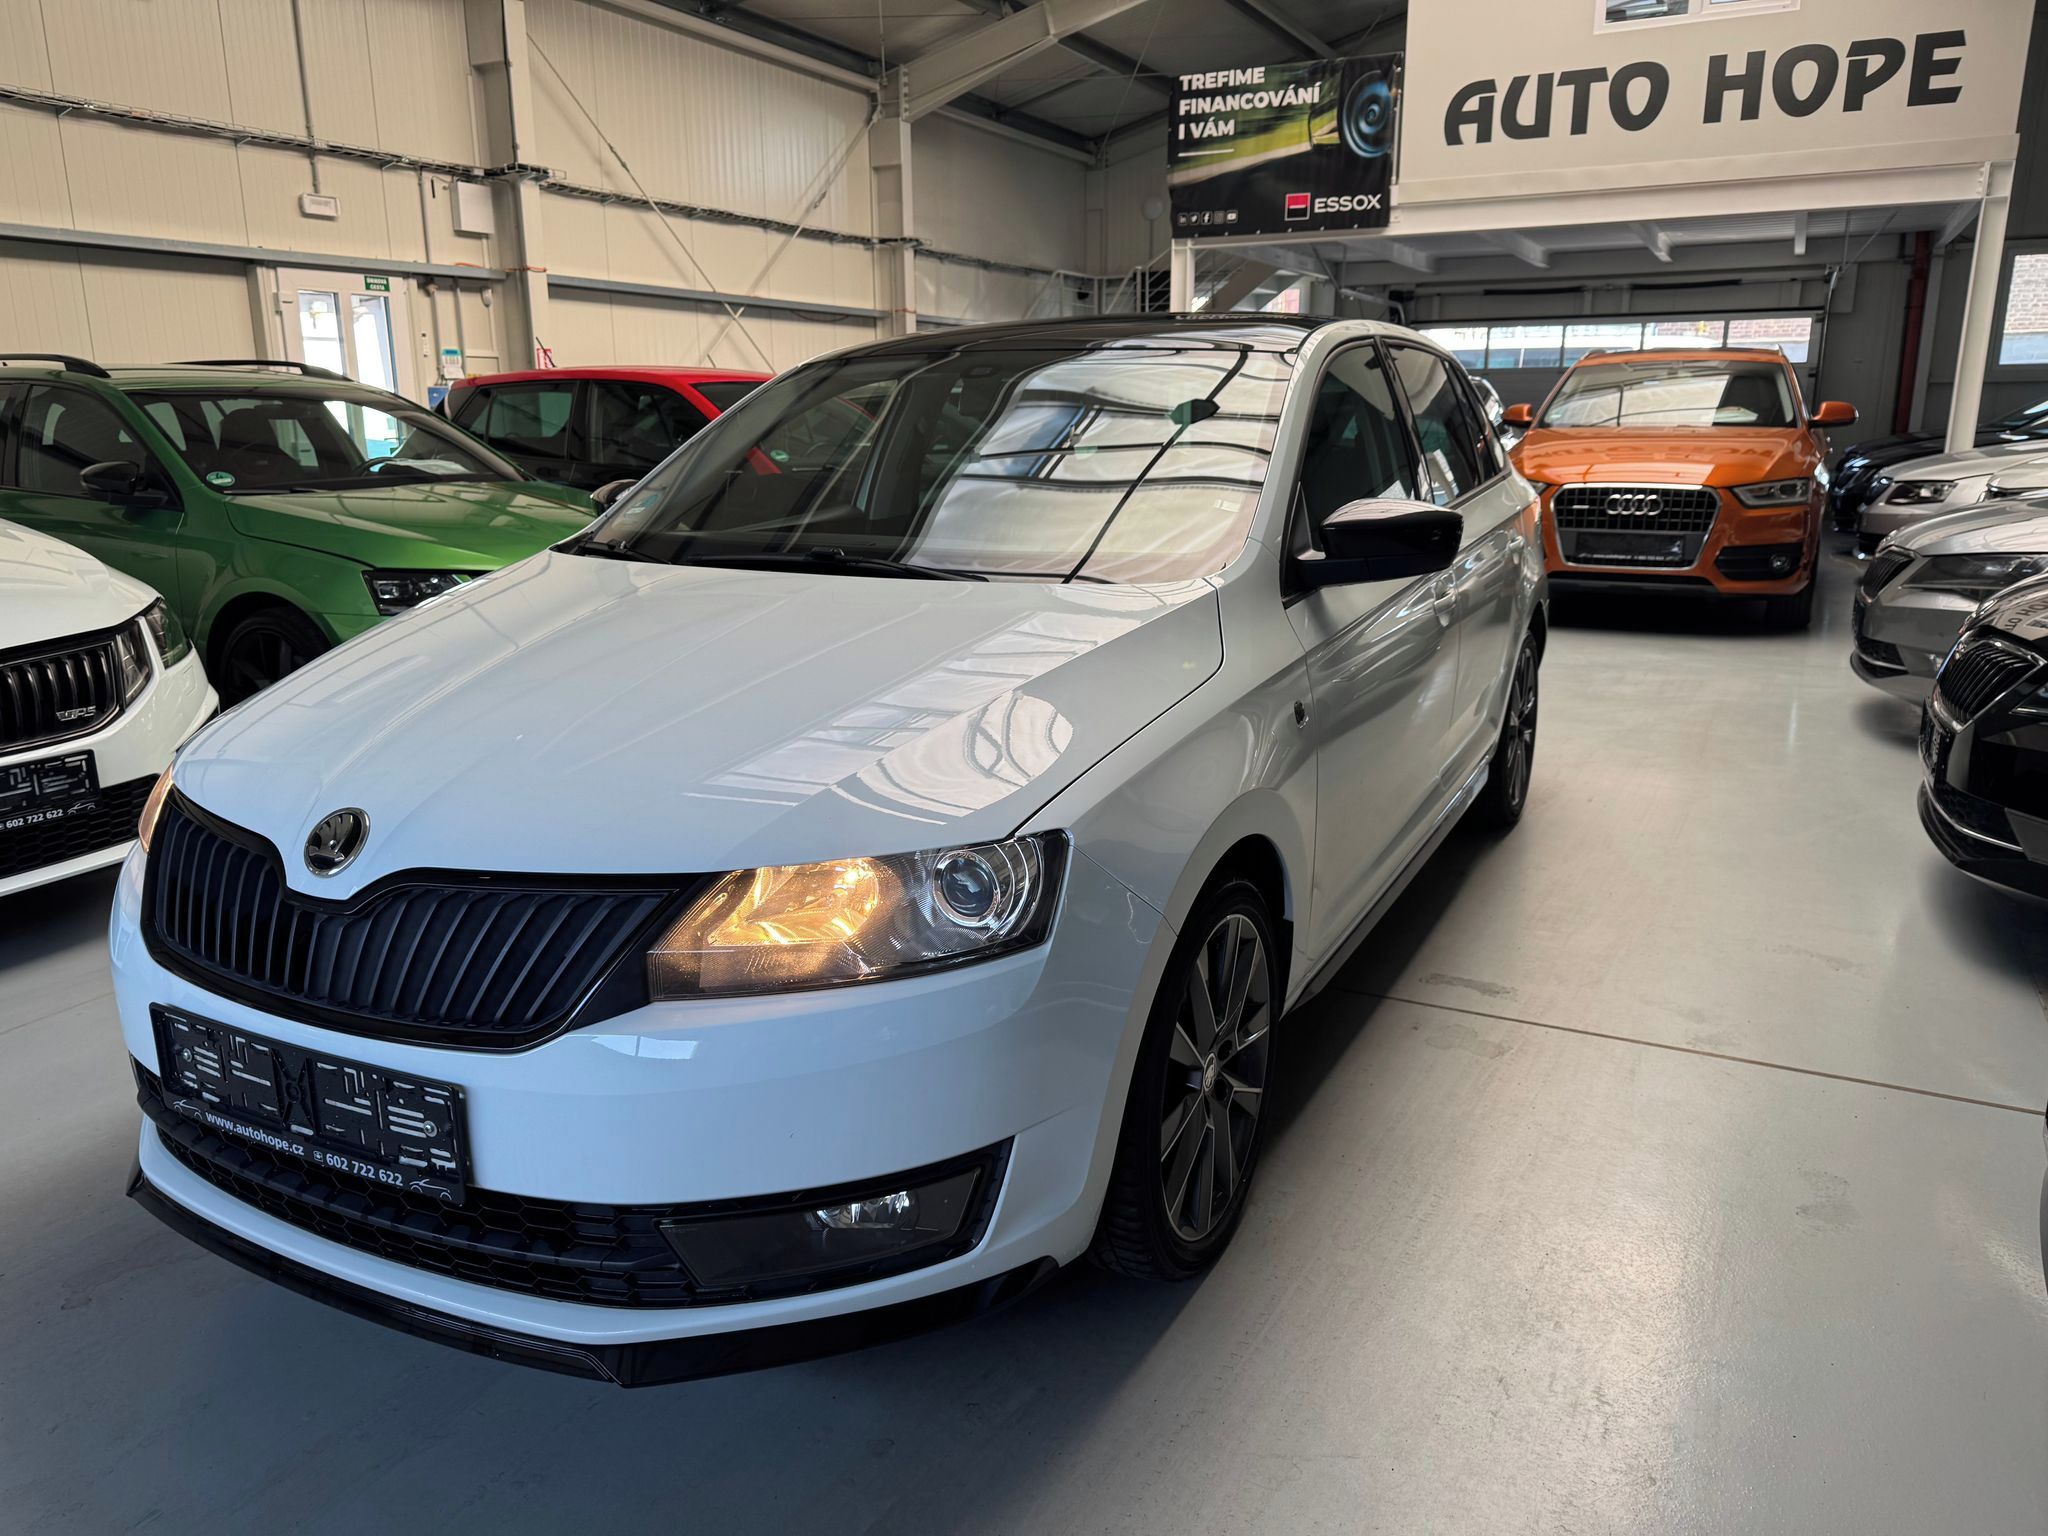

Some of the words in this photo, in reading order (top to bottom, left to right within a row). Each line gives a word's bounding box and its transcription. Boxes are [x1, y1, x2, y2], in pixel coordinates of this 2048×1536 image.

[1179, 66, 1266, 92] TREFIME
[1444, 60, 1670, 146] AUTO
[1703, 29, 1967, 124] HOPE
[1178, 82, 1322, 116] FINANCOVÁNÍ
[1178, 123, 1186, 140] I
[1190, 116, 1236, 139] VÁM
[1313, 193, 1382, 214] ESSOX
[6, 818, 24, 829] 602
[26, 813, 45, 824] 722
[46, 808, 64, 820] 622
[205, 1111, 305, 1157] www.autohope.cz
[325, 1153, 349, 1172] 602
[352, 1161, 376, 1179] 722
[378, 1168, 404, 1187] 622
